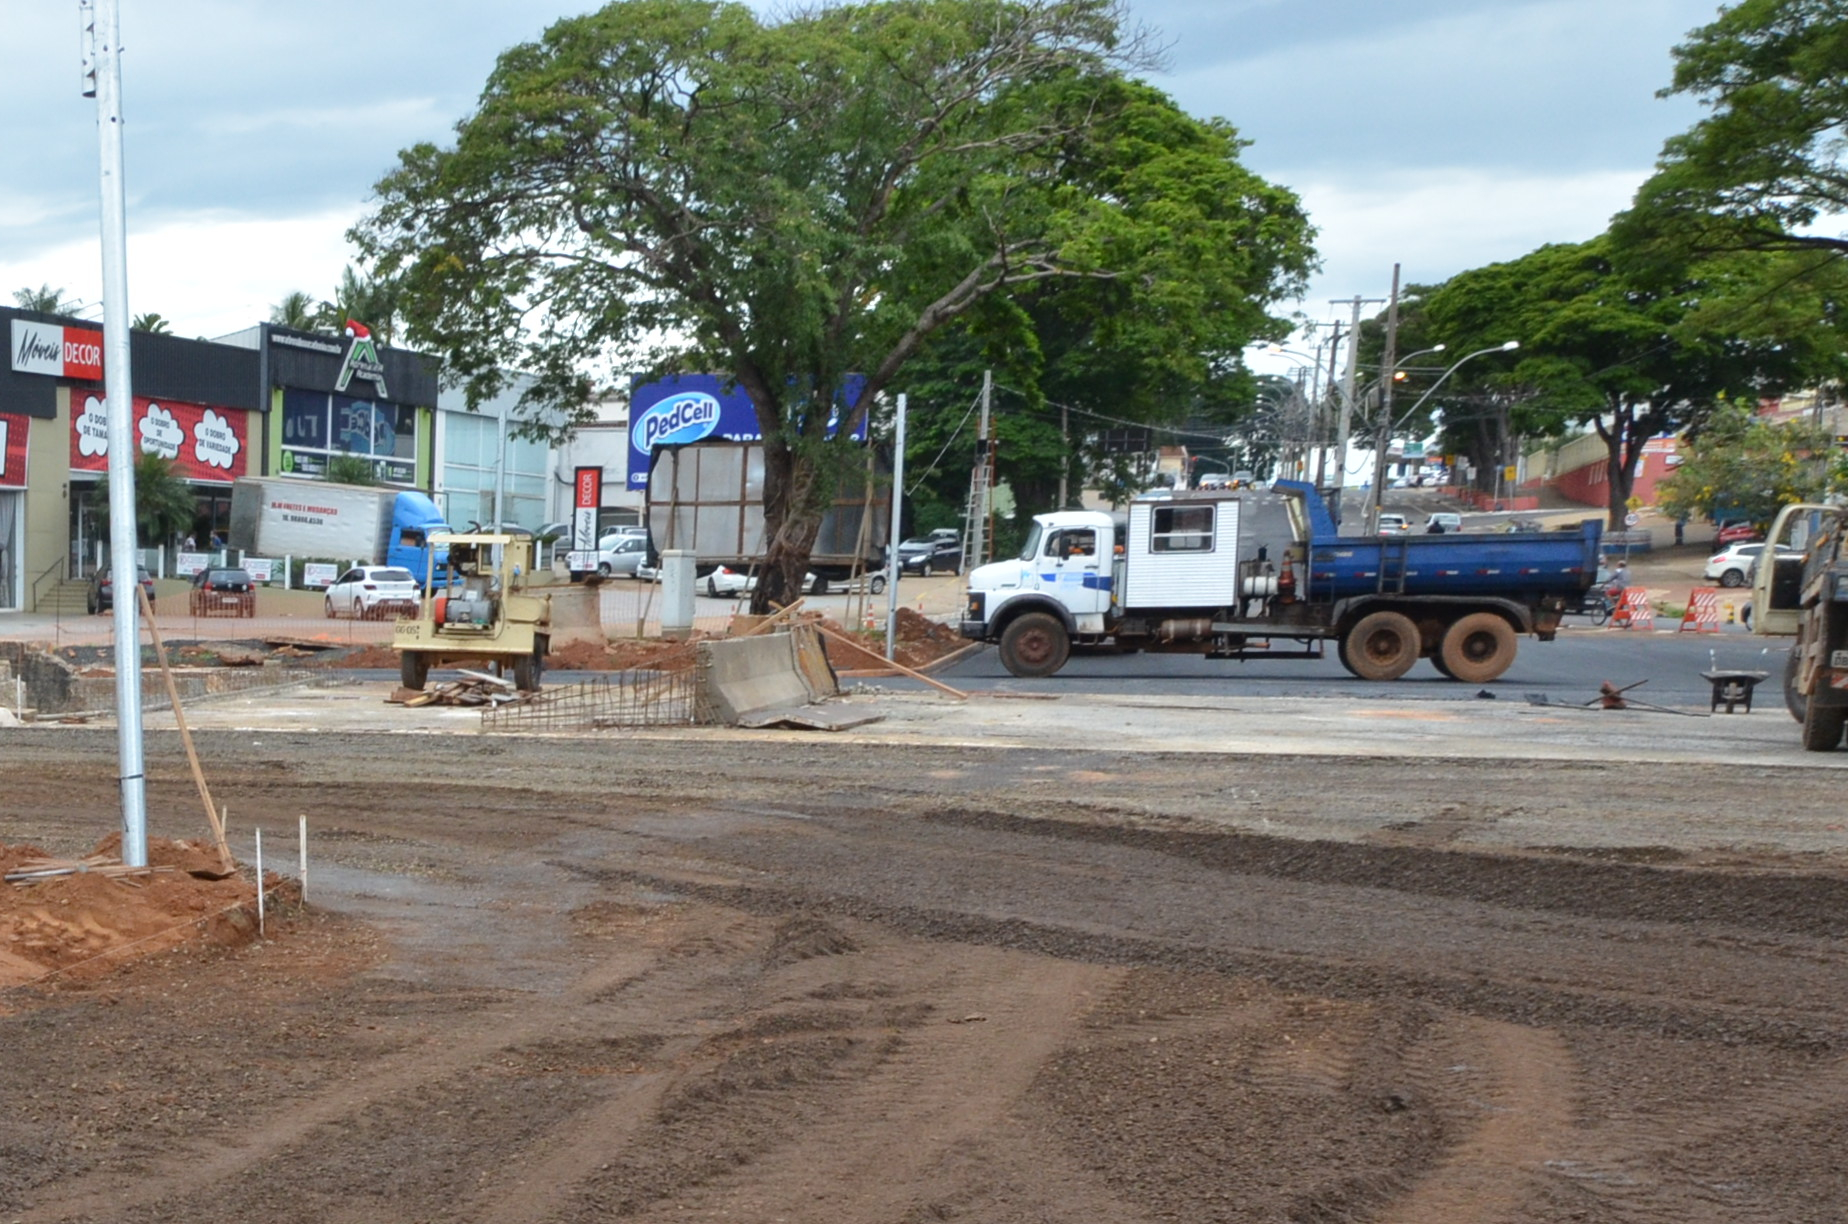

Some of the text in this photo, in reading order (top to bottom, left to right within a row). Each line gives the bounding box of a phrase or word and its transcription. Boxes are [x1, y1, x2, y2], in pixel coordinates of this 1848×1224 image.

[16, 328, 101, 367] Móveis DECOR
[89, 413, 94, 423] O
[155, 418, 170, 429] DOBRO
[83, 425, 91, 436] DE
[643, 401, 714, 449] PedCell
[156, 429, 163, 438] DE
[209, 429, 226, 441] DOBRO
[143, 437, 176, 451] OPORTUNIDADE
[198, 439, 232, 455] DE VARIEDADE
[582, 474, 593, 505] DECOR
